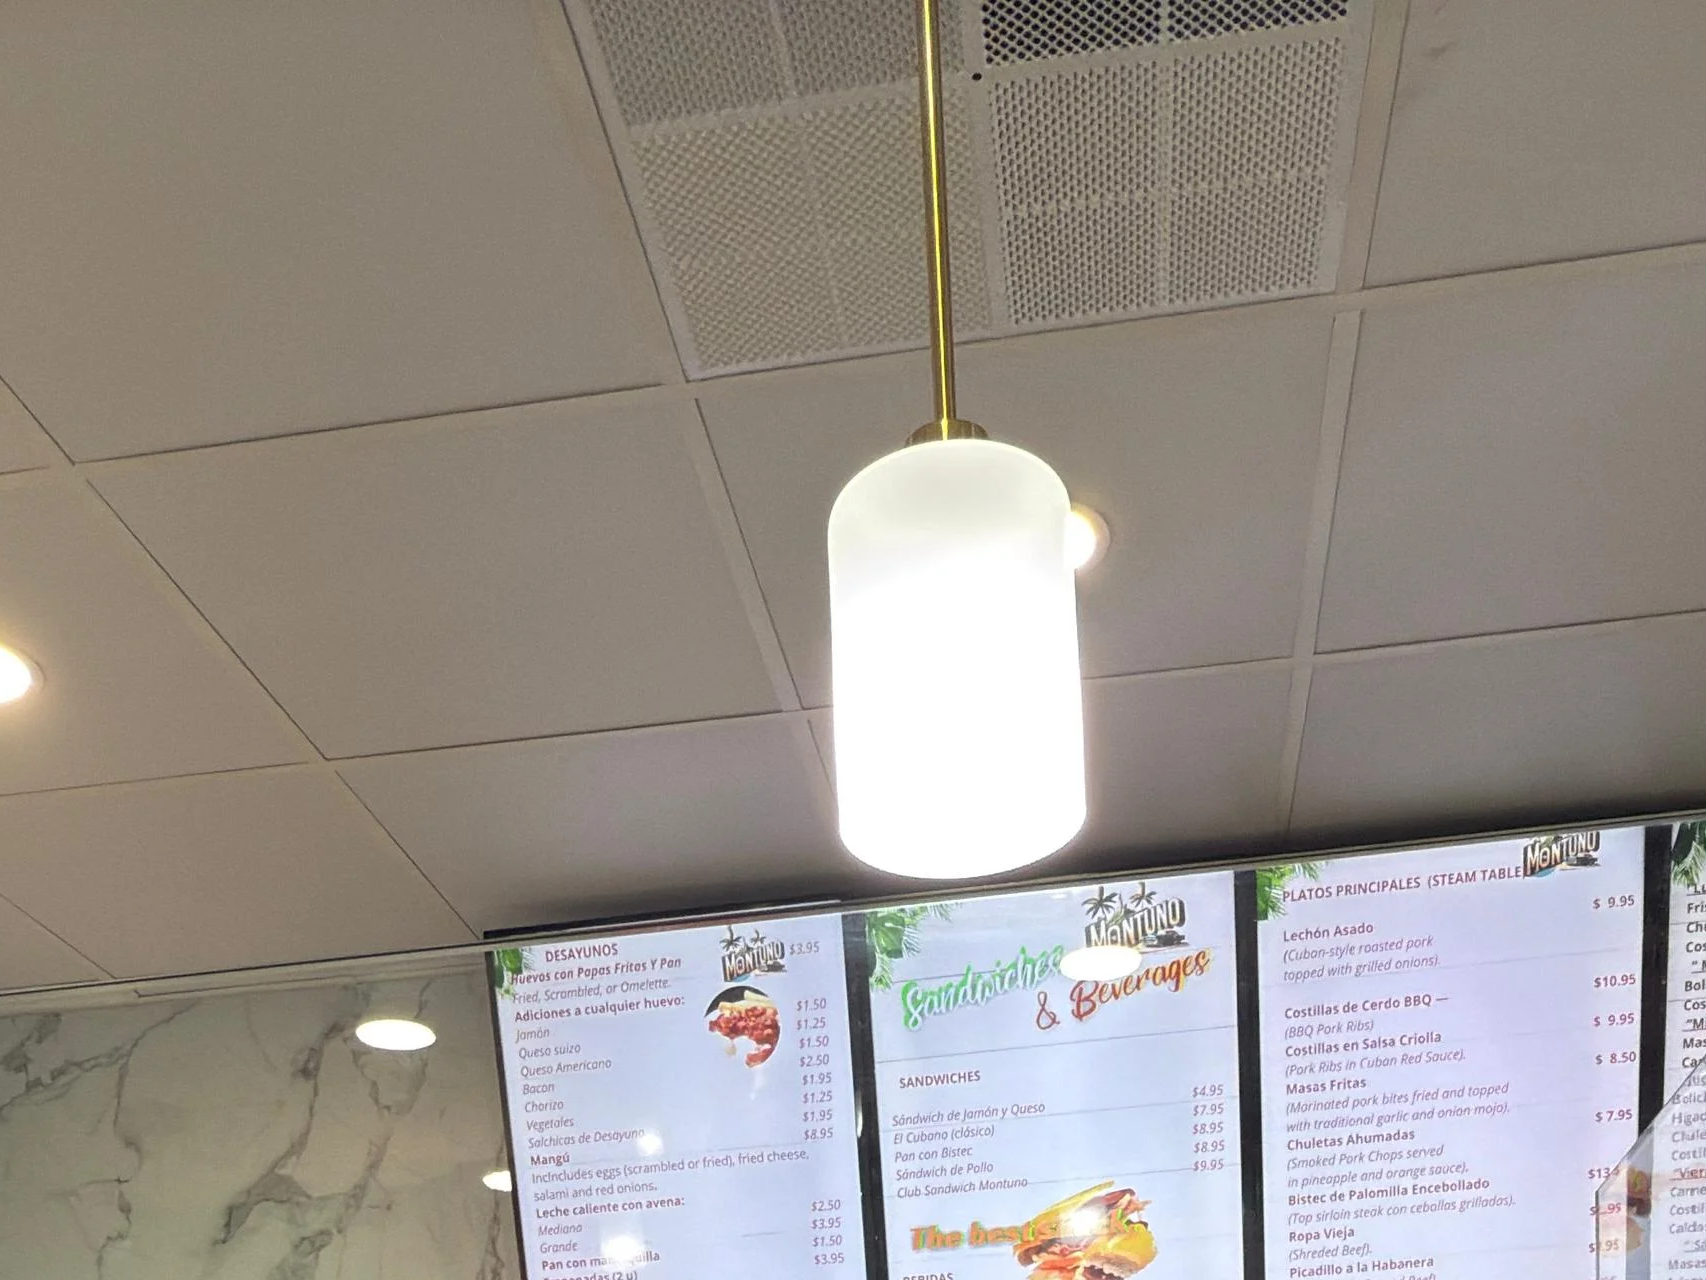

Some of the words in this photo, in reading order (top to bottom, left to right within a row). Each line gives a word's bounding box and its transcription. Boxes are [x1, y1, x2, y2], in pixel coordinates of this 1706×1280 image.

[1281, 886, 1332, 905] PLATOS
[1336, 876, 1420, 896] PRINCIPALES
[1427, 870, 1476, 888] (STEAM
[1085, 896, 1185, 948] MONTUNO
[1283, 927, 1329, 942] Lechón
[1333, 922, 1373, 937] Asado
[545, 943, 618, 962] DESAYUNOS
[790, 941, 819, 955] $3.95
[722, 941, 785, 982] MONTUNO
[902, 945, 1065, 1031] Sandwiches
[1036, 991, 1060, 1030] &
[1070, 948, 1211, 1023] Beverages
[1594, 973, 1635, 988] $10.95
[515, 1008, 571, 1022] Adiciones
[574, 1007, 581, 1016] a
[585, 999, 640, 1016] cualquier
[644, 997, 684, 1009] huevo:
[797, 997, 826, 1012] $1.50
[1285, 1004, 1339, 1019] Costillas
[1342, 1001, 1358, 1013] de
[1362, 997, 1400, 1011] Cerdo
[1404, 994, 1431, 1007] BBQ
[797, 1016, 825, 1030] $1.25
[799, 1035, 829, 1049] $1.50
[518, 1047, 551, 1062] Queso
[553, 1043, 581, 1055] suizo
[799, 1053, 829, 1067] $2.50
[520, 1065, 553, 1080] Queso
[555, 1059, 611, 1073] Americano
[802, 1072, 831, 1086] $1.95
[899, 1070, 980, 1088] SANDWICHES
[522, 1083, 554, 1095] Bacon
[1192, 1084, 1223, 1098] $4.95
[524, 1100, 563, 1112] Chorizo
[892, 1111, 943, 1126] Sándwich
[947, 1110, 960, 1121] de
[961, 1105, 998, 1123] Jamón
[1000, 1107, 1008, 1120] y
[1011, 1103, 1045, 1117] Queso
[1193, 1102, 1224, 1116] $7.95
[526, 1116, 574, 1133] Vegetales
[894, 1133, 903, 1144] El
[906, 1127, 948, 1143] Cubano
[951, 1124, 994, 1140] (clásico)
[1192, 1121, 1223, 1135] $8.95
[1193, 1139, 1224, 1153] $8.95
[1287, 1137, 1342, 1151] Chuletas
[1346, 1129, 1414, 1145] Ahumadas
[530, 1152, 569, 1166] Mangú
[1192, 1158, 1224, 1171] $9.95
[896, 1165, 947, 1181] Sándwich
[950, 1164, 963, 1176] de
[966, 1161, 993, 1173] Pollo
[897, 1185, 921, 1198] Club
[924, 1181, 975, 1196] Sandwich
[978, 1178, 1030, 1191] Montuno
[1288, 1194, 1326, 1205] Bistec
[1329, 1190, 1344, 1202] de
[1349, 1185, 1408, 1200] Palomilla
[1412, 1178, 1489, 1195] Encebollado
[536, 1206, 569, 1218] Leche
[572, 1203, 618, 1215] caliente
[622, 1201, 642, 1211] con
[645, 1197, 684, 1208] avena:
[910, 1223, 964, 1252] The
[1289, 1231, 1320, 1244] Ropa
[1323, 1226, 1354, 1240] Vieja
